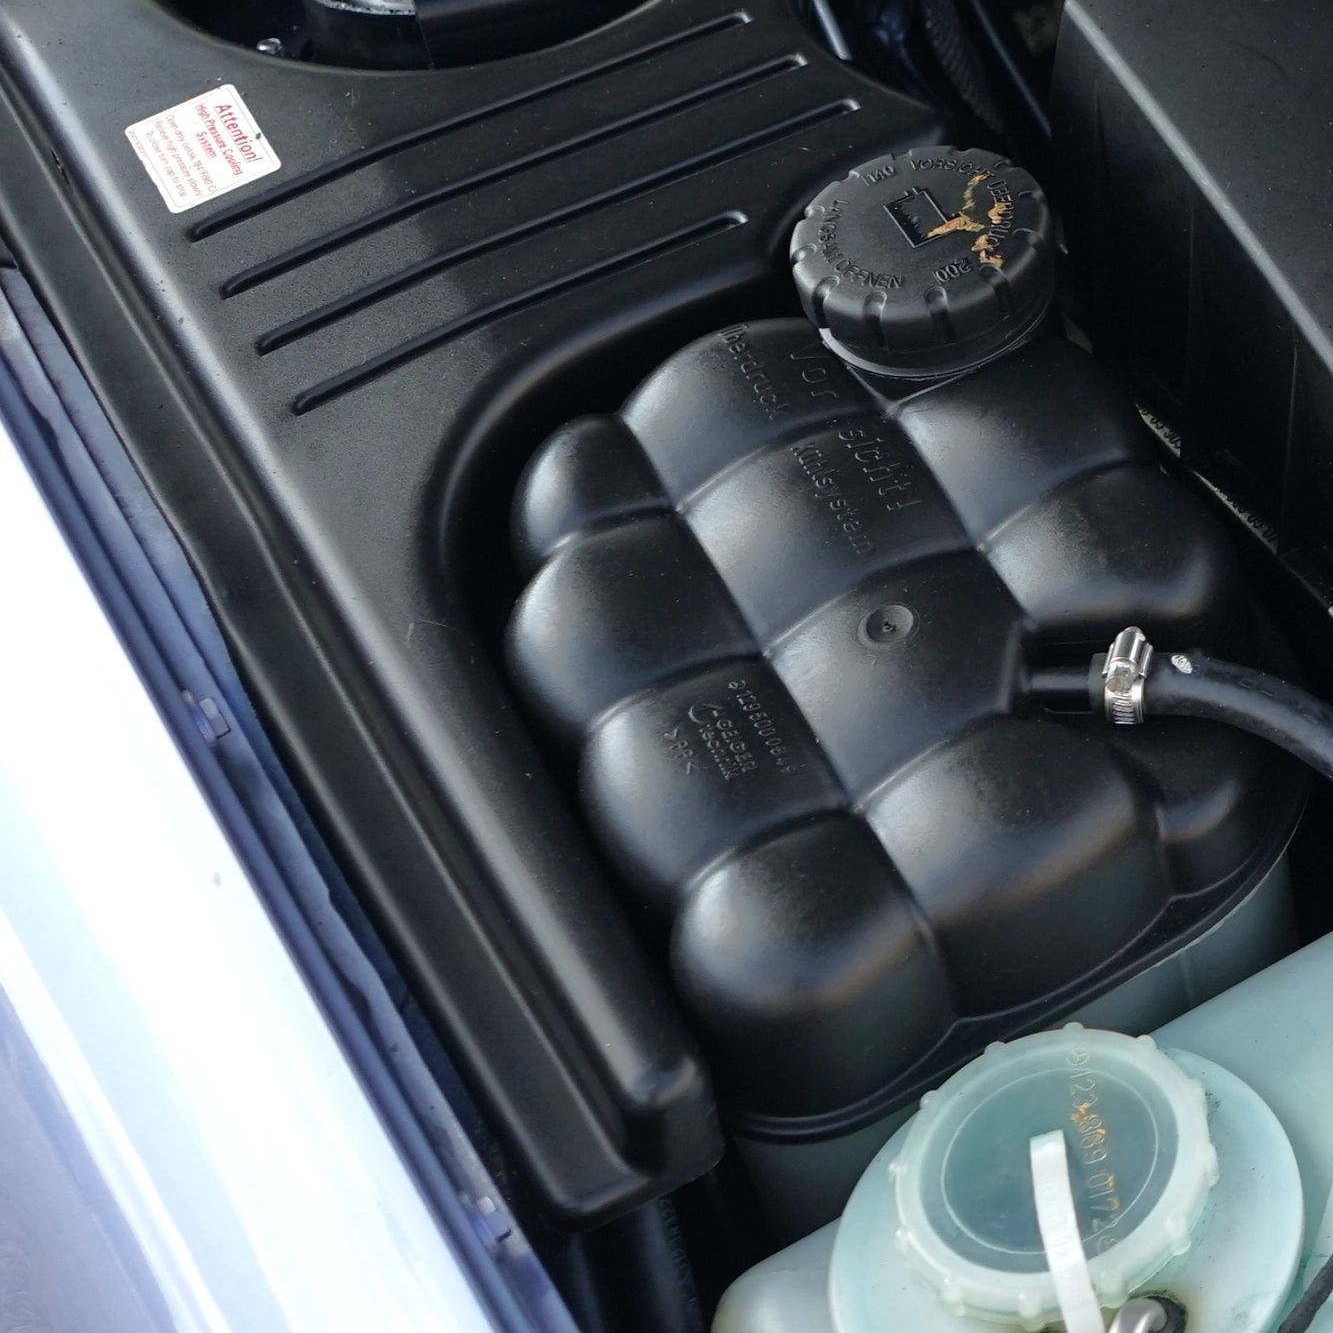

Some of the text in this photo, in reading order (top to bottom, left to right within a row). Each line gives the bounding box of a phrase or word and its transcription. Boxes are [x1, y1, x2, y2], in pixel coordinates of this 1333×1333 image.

[196, 103, 243, 175] High Pressure Cooling
[196, 131, 217, 159] System
[215, 104, 263, 162] Attention!
